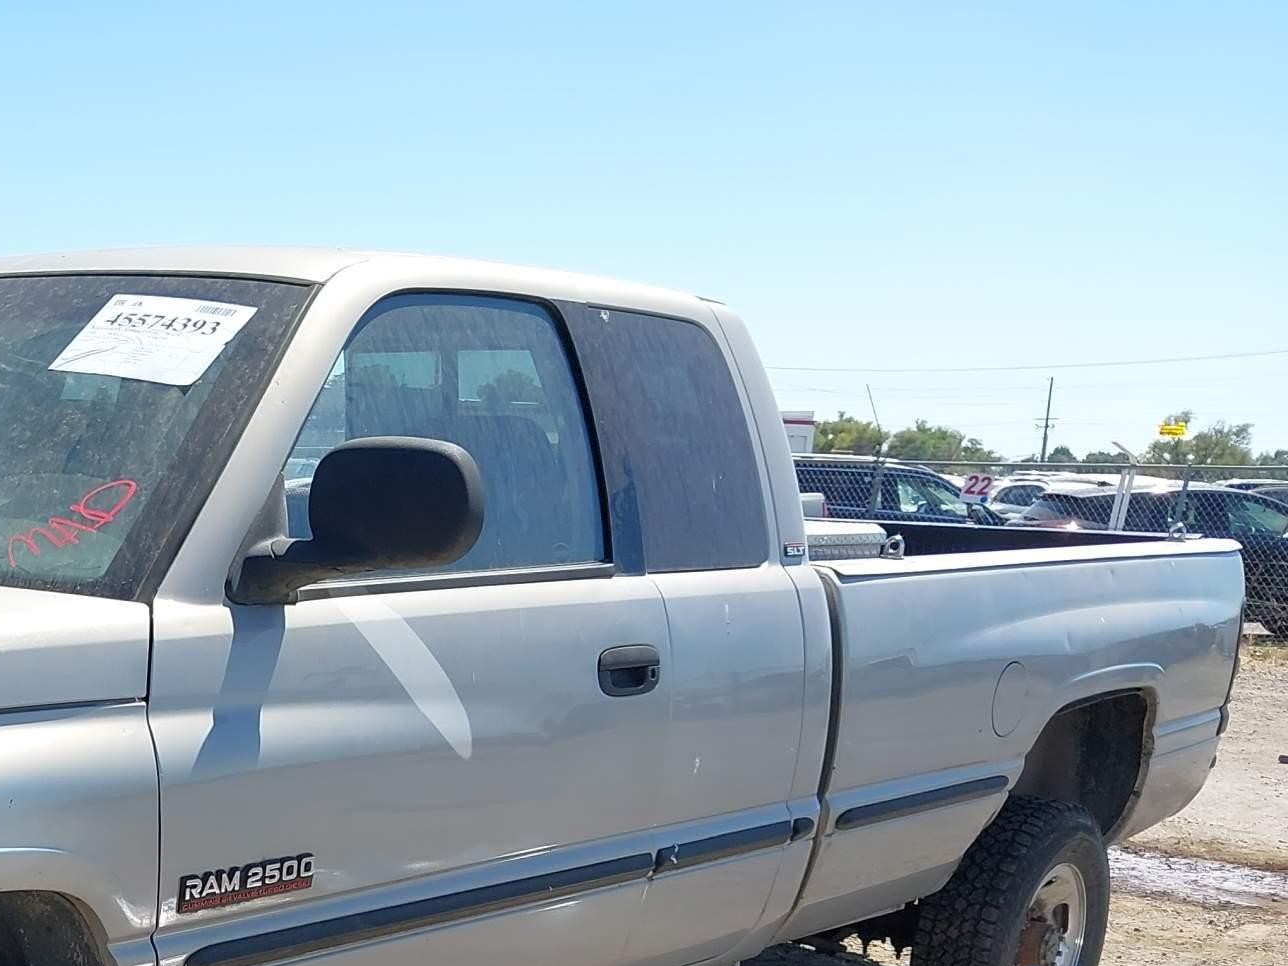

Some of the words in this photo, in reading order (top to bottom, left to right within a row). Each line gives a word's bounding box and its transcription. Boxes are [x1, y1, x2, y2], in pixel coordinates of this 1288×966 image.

[105, 312, 222, 336] 45574393
[964, 475, 992, 496] 22
[786, 547, 804, 556] SLT
[185, 870, 241, 901] RAM
[246, 856, 316, 889] 2500
